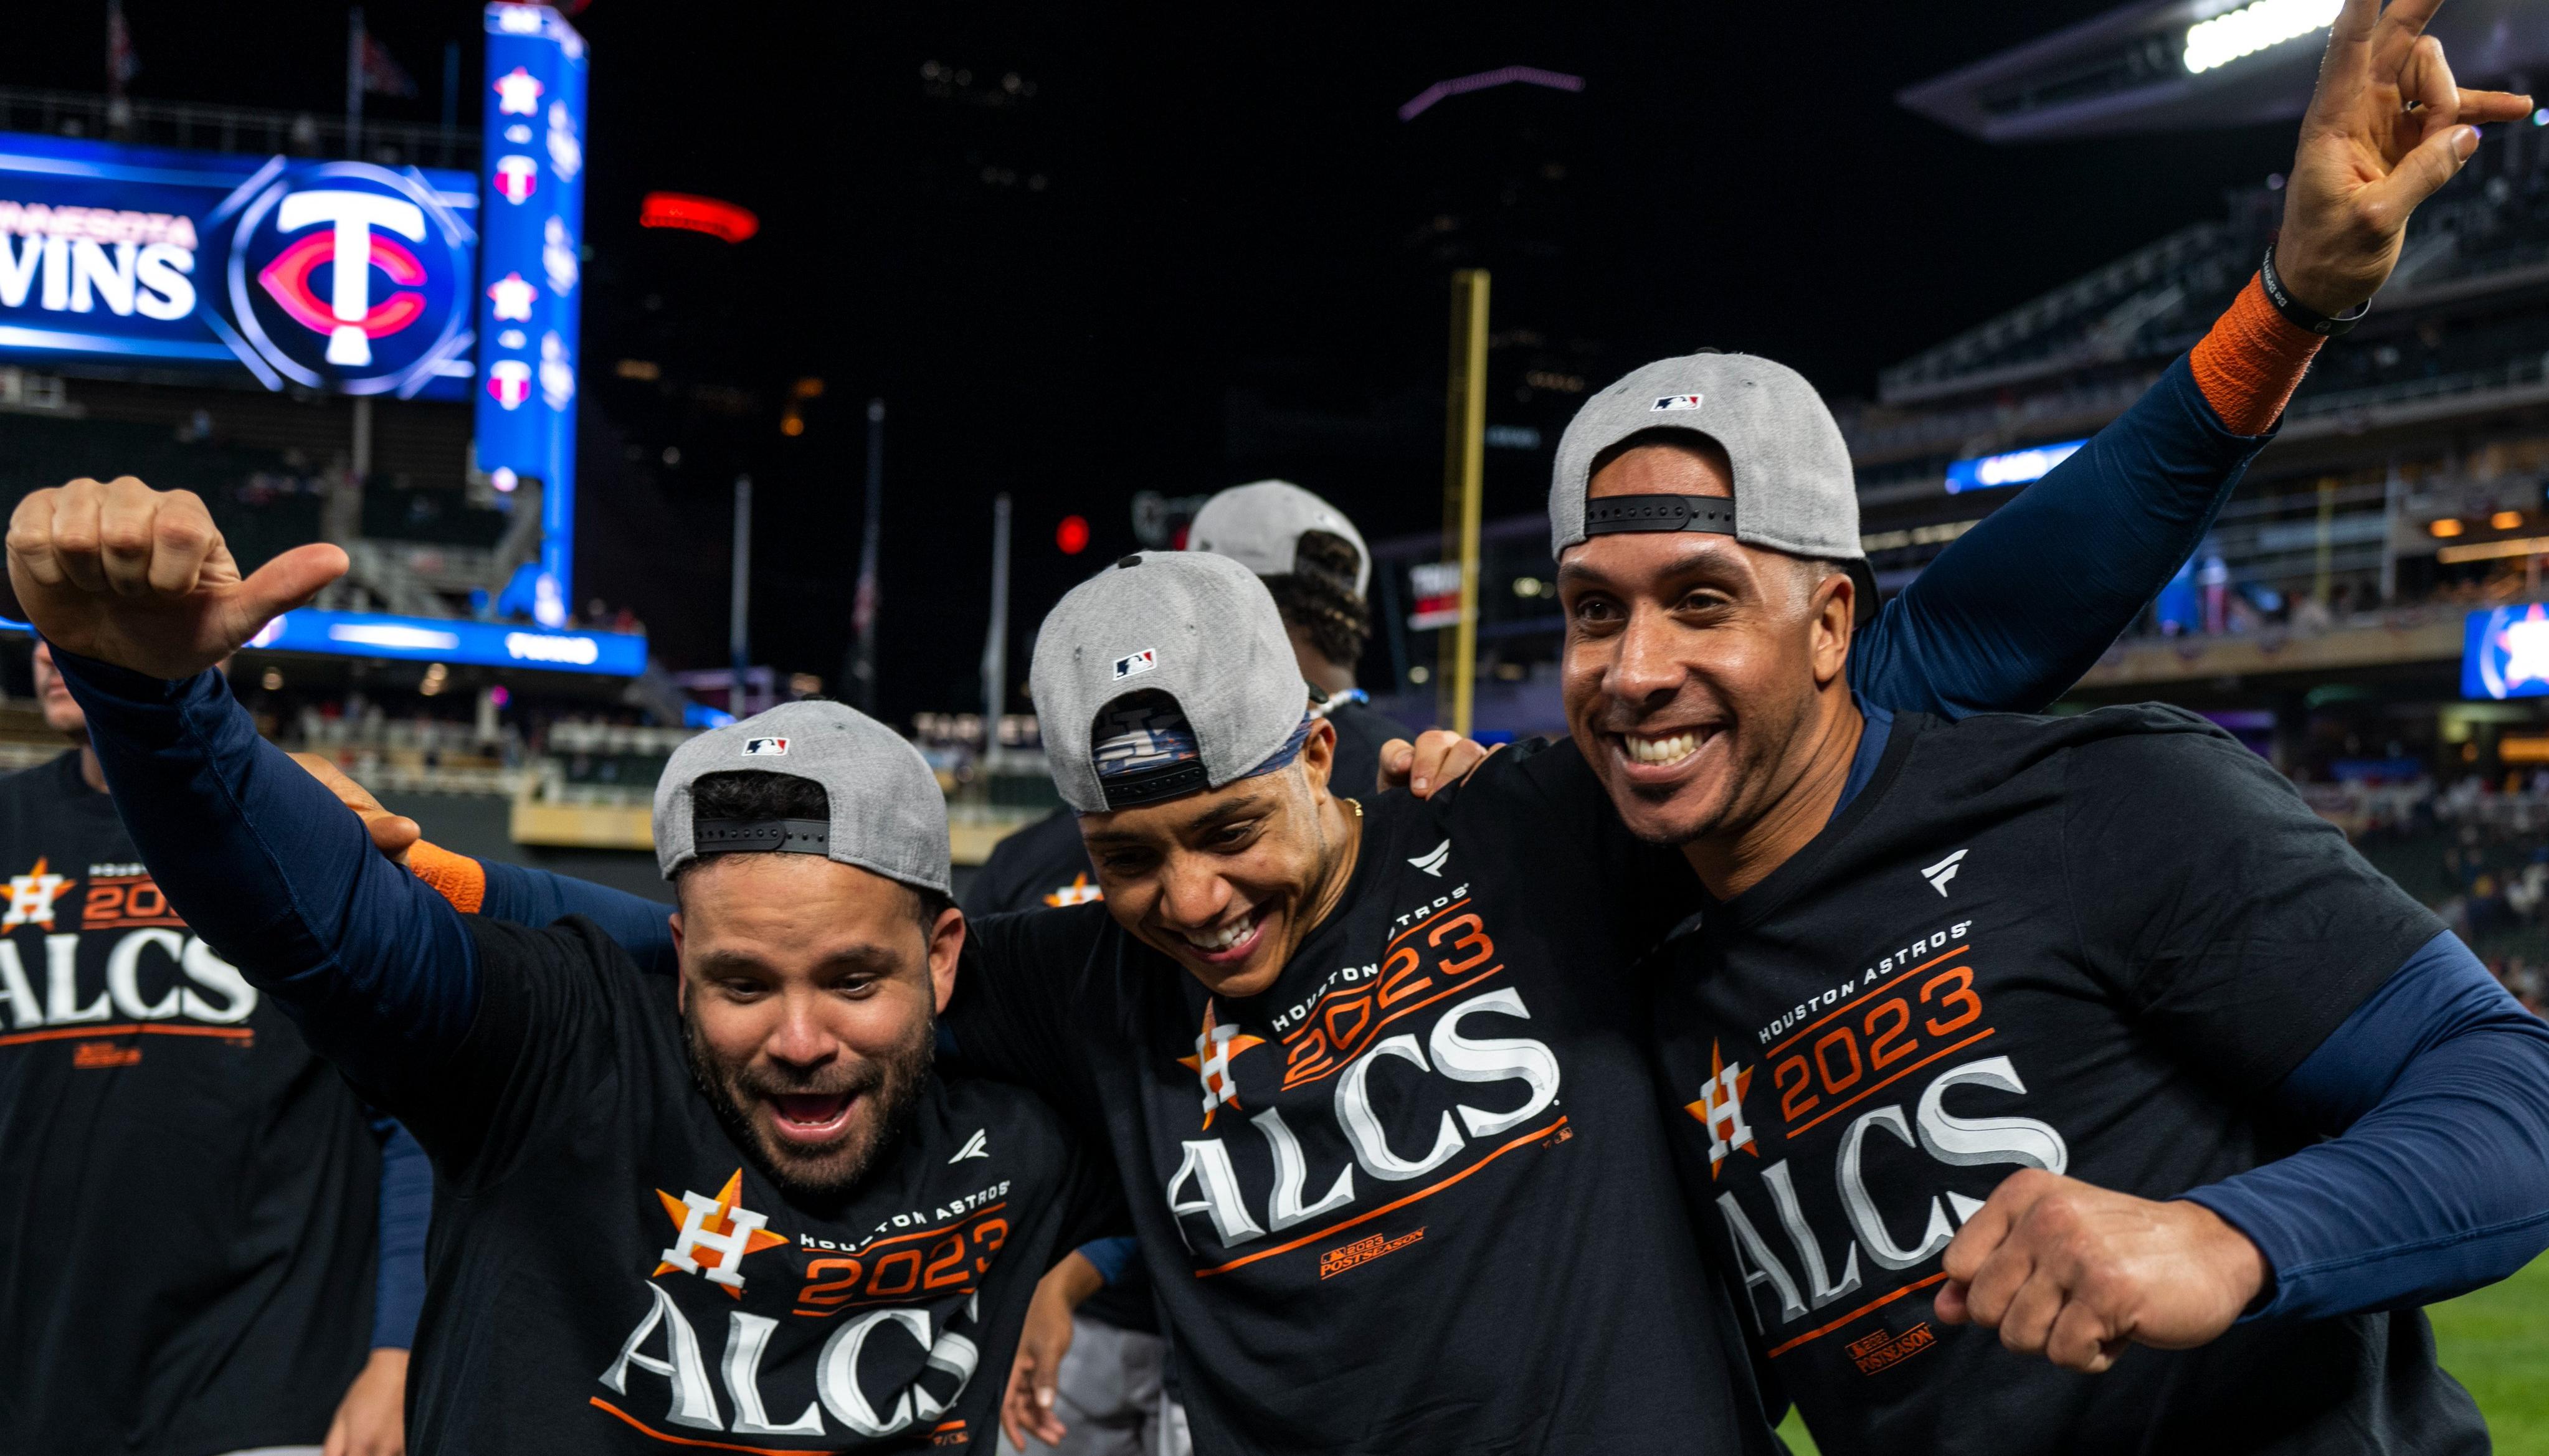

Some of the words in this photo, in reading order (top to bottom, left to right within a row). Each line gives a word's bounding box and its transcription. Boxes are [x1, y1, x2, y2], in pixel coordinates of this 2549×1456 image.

[82, 882, 179, 919] 20
[1283, 912, 1495, 1085] 2023
[1759, 980, 1854, 1044] HOUSTON
[1864, 922, 1967, 985] ASTROS
[1774, 966, 1982, 1123] 2023
[1167, 986, 1560, 1255] ALCS
[936, 1181, 1010, 1221] ASTROS
[1347, 1236, 1384, 1254] 2023
[1717, 1054, 2068, 1335] ALCS
[797, 1218, 1009, 1305] 2023
[1321, 1227, 1425, 1276] POSTSEASON
